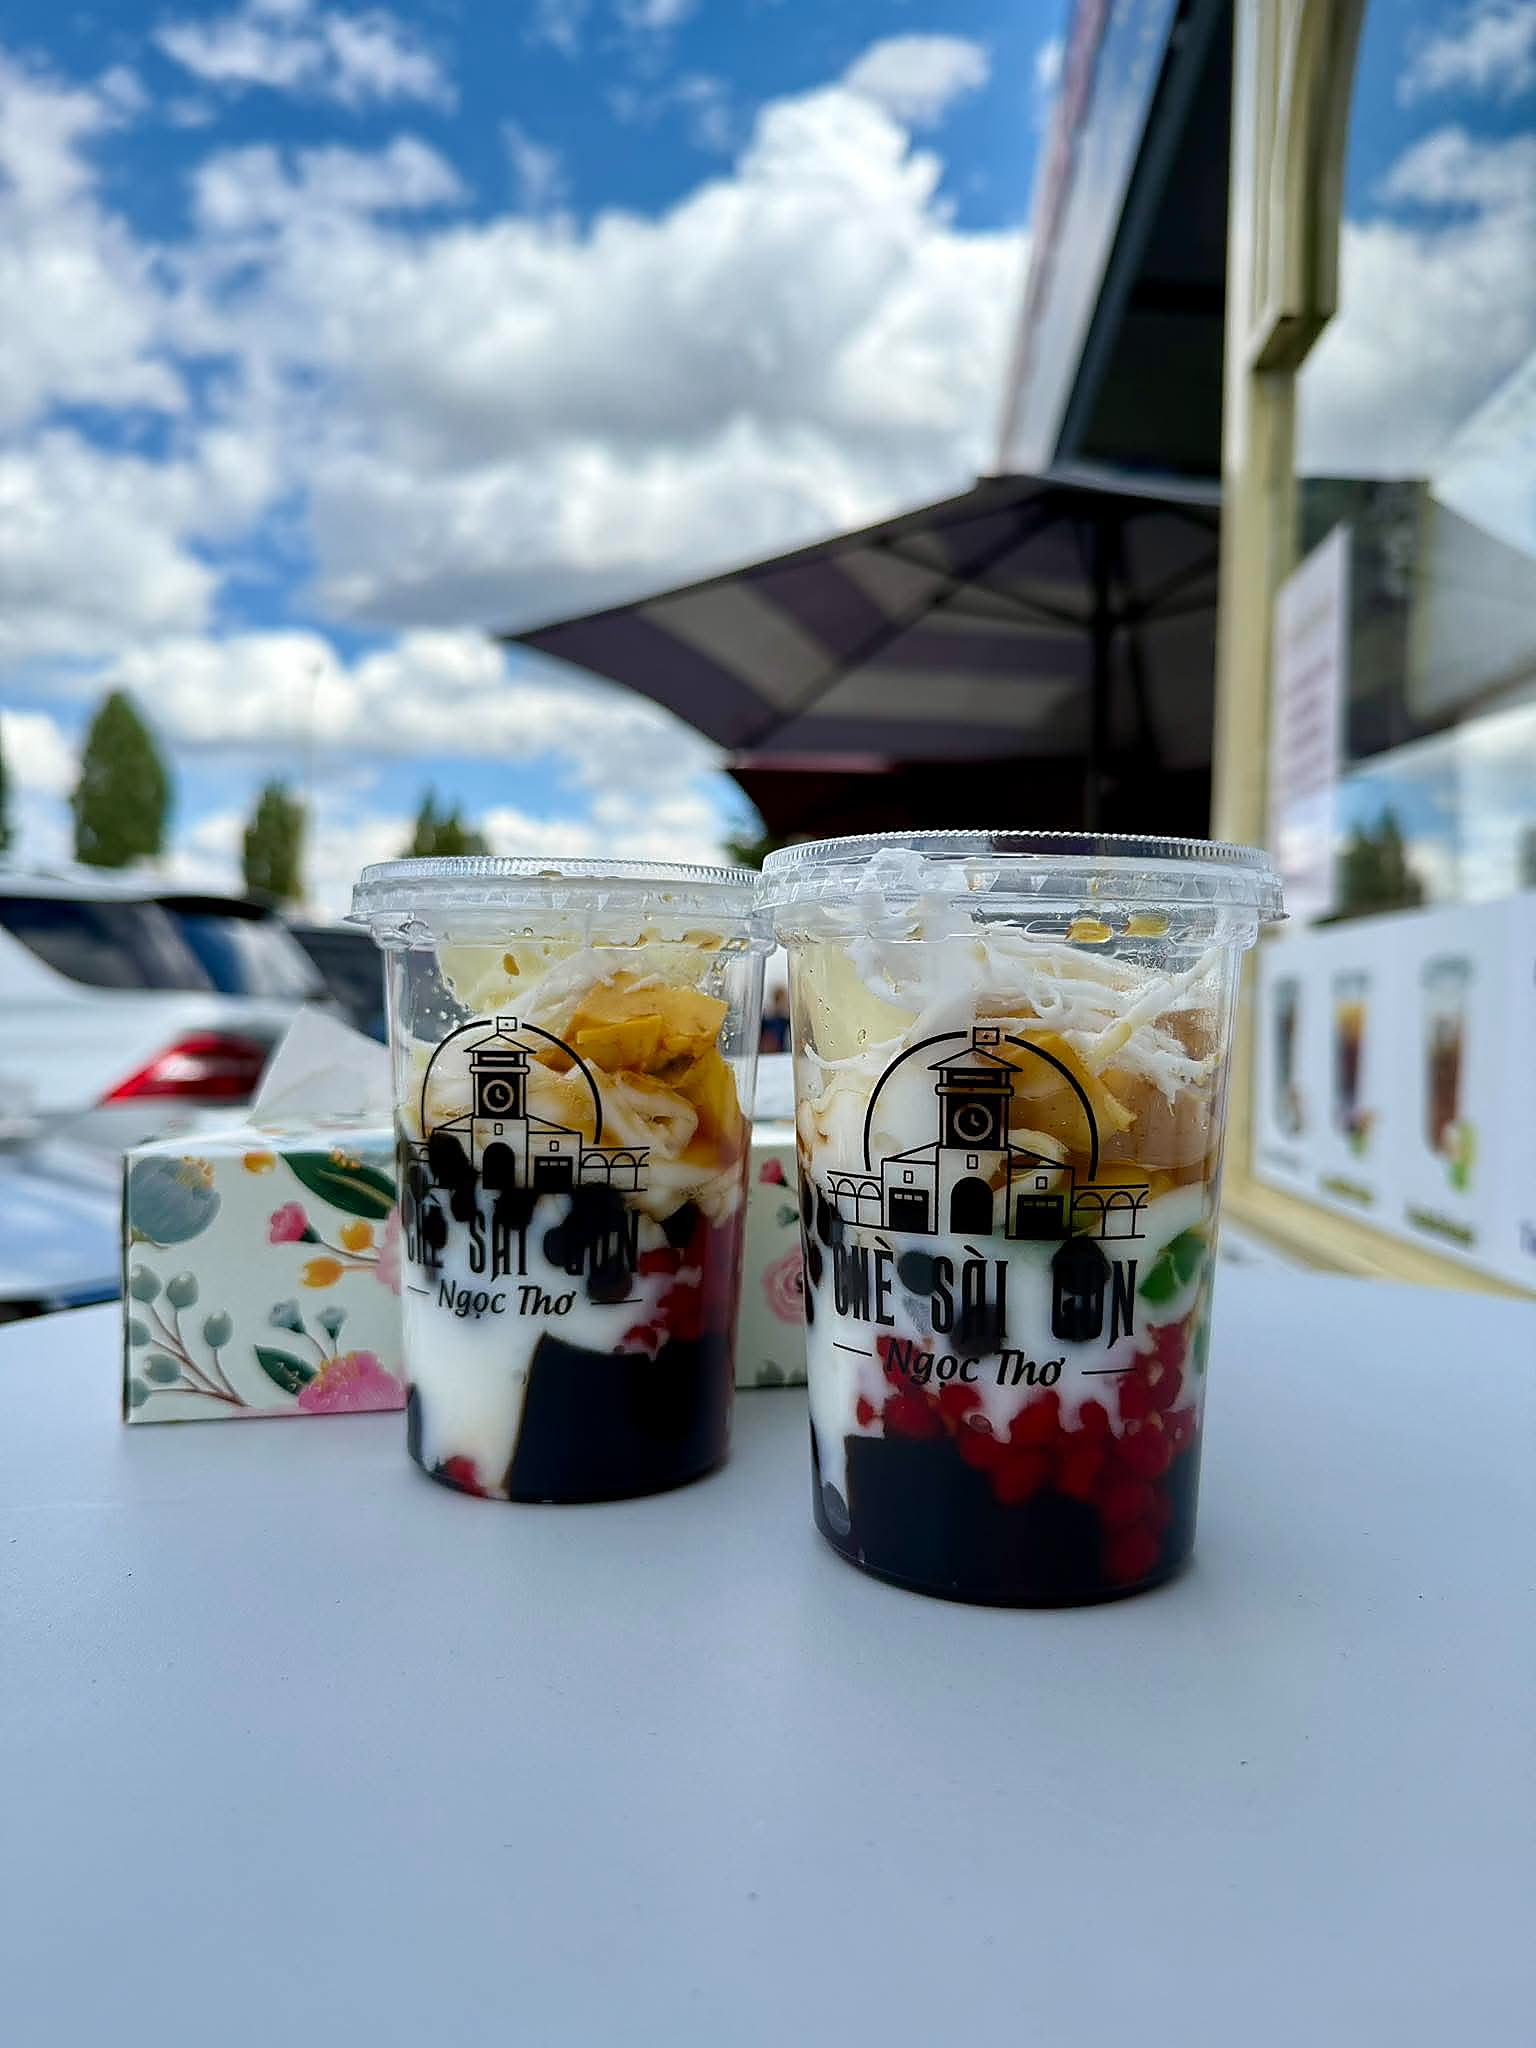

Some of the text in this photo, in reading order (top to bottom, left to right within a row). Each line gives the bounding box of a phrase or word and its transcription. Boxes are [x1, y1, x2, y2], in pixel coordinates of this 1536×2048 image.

[438, 1279, 577, 1319] Ngọc Thơ
[885, 1338, 1066, 1389] Ngọc Thơ
